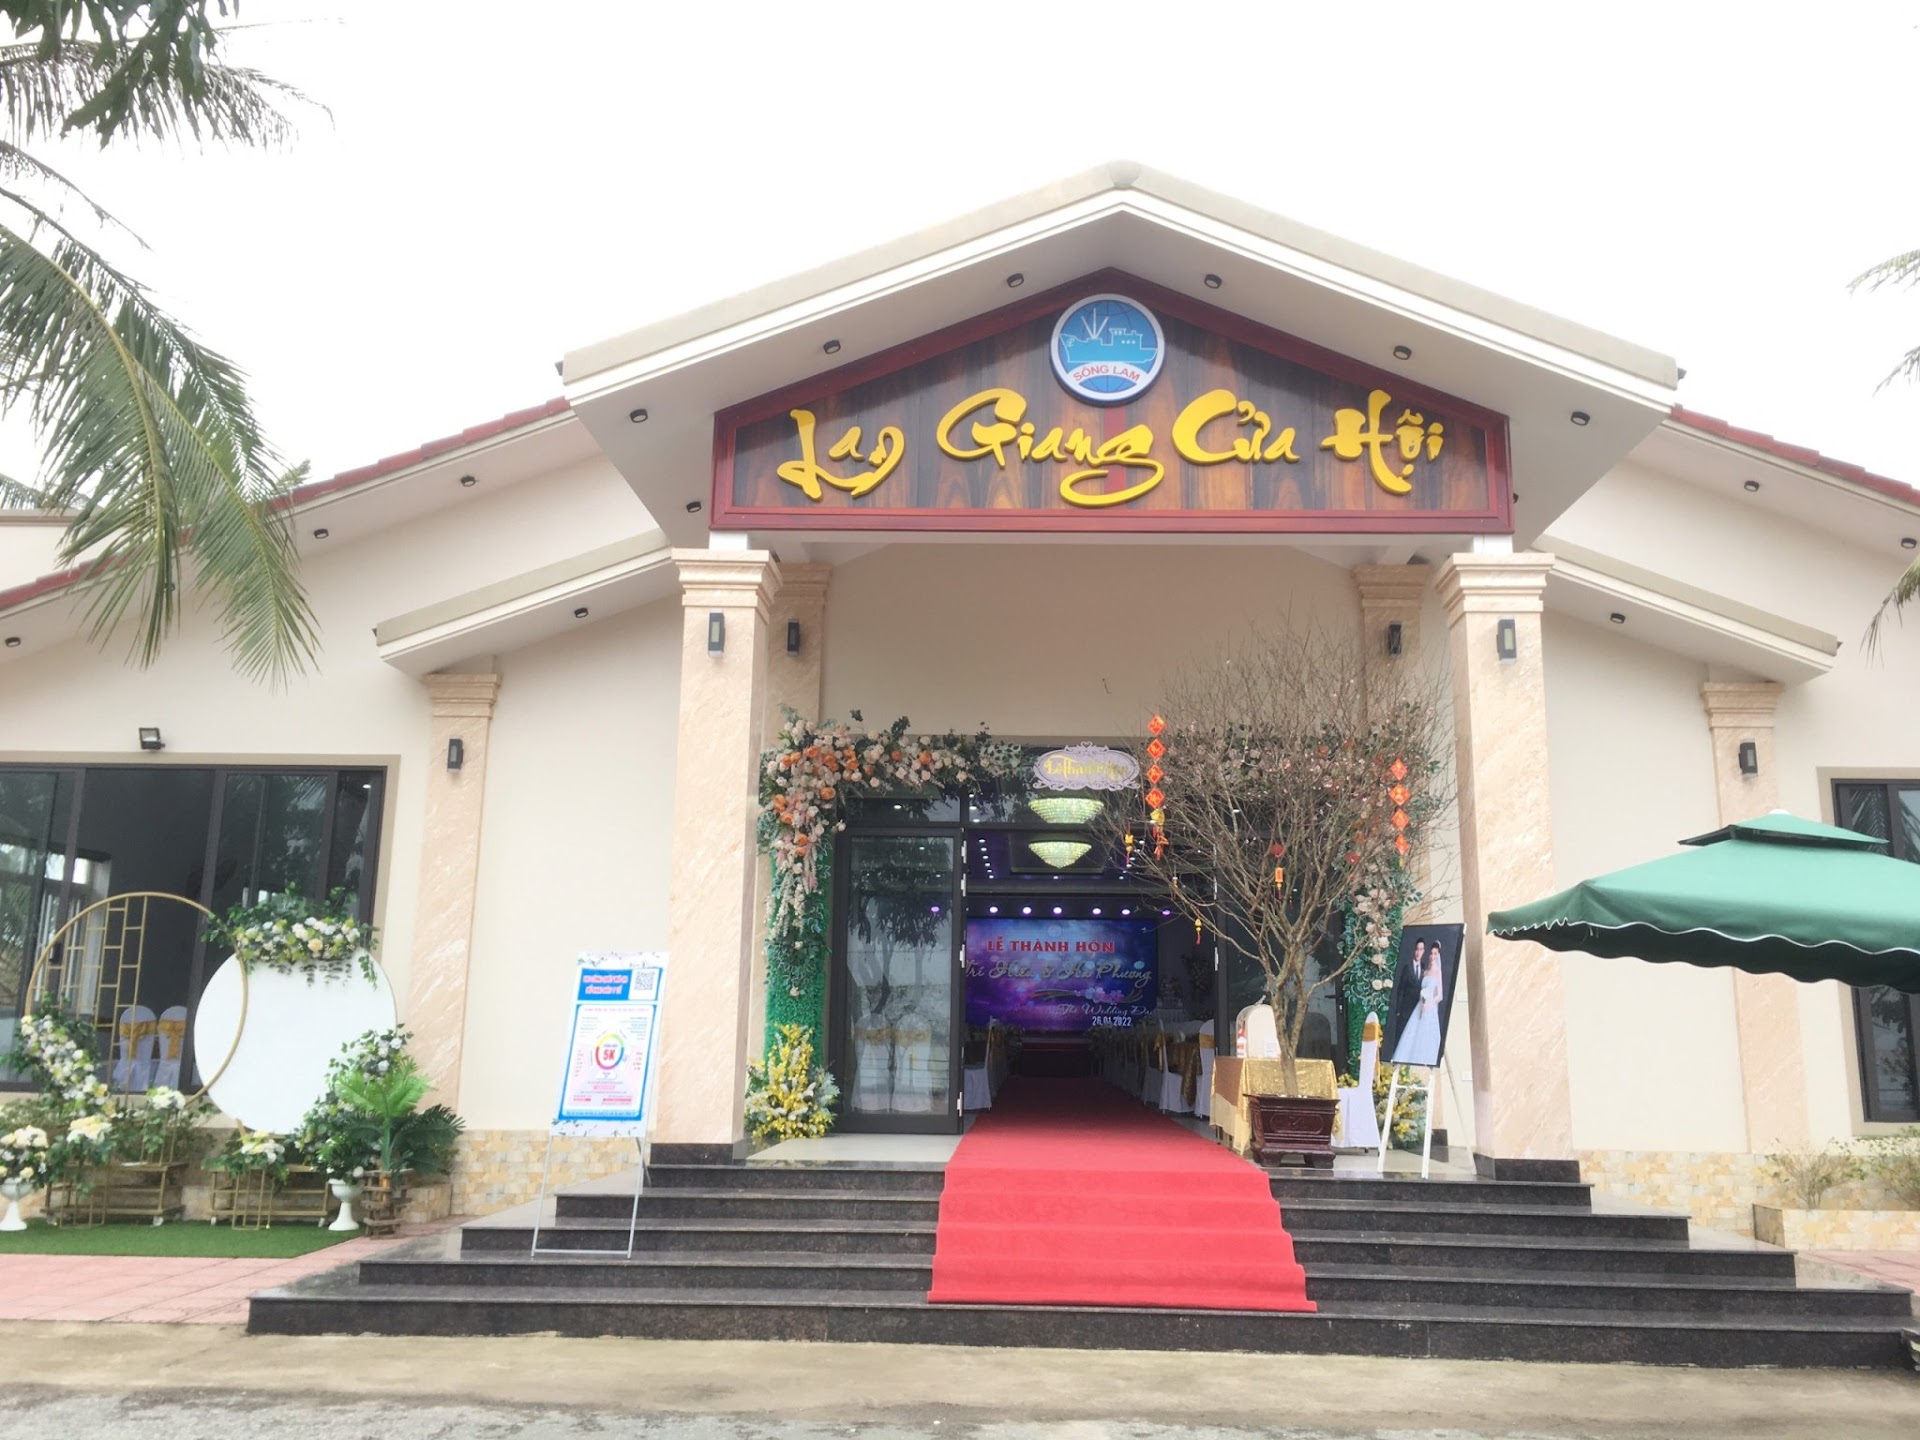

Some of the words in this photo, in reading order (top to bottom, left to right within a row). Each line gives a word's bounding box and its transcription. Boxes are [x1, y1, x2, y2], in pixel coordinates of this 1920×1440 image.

[1073, 364, 1110, 382] SÔNG
[1113, 366, 1140, 382] LAM
[936, 387, 1165, 508] Giang
[1172, 388, 1301, 464] Cửa
[1010, 938, 1069, 952] THÀNH
[603, 1049, 616, 1060] 5K
